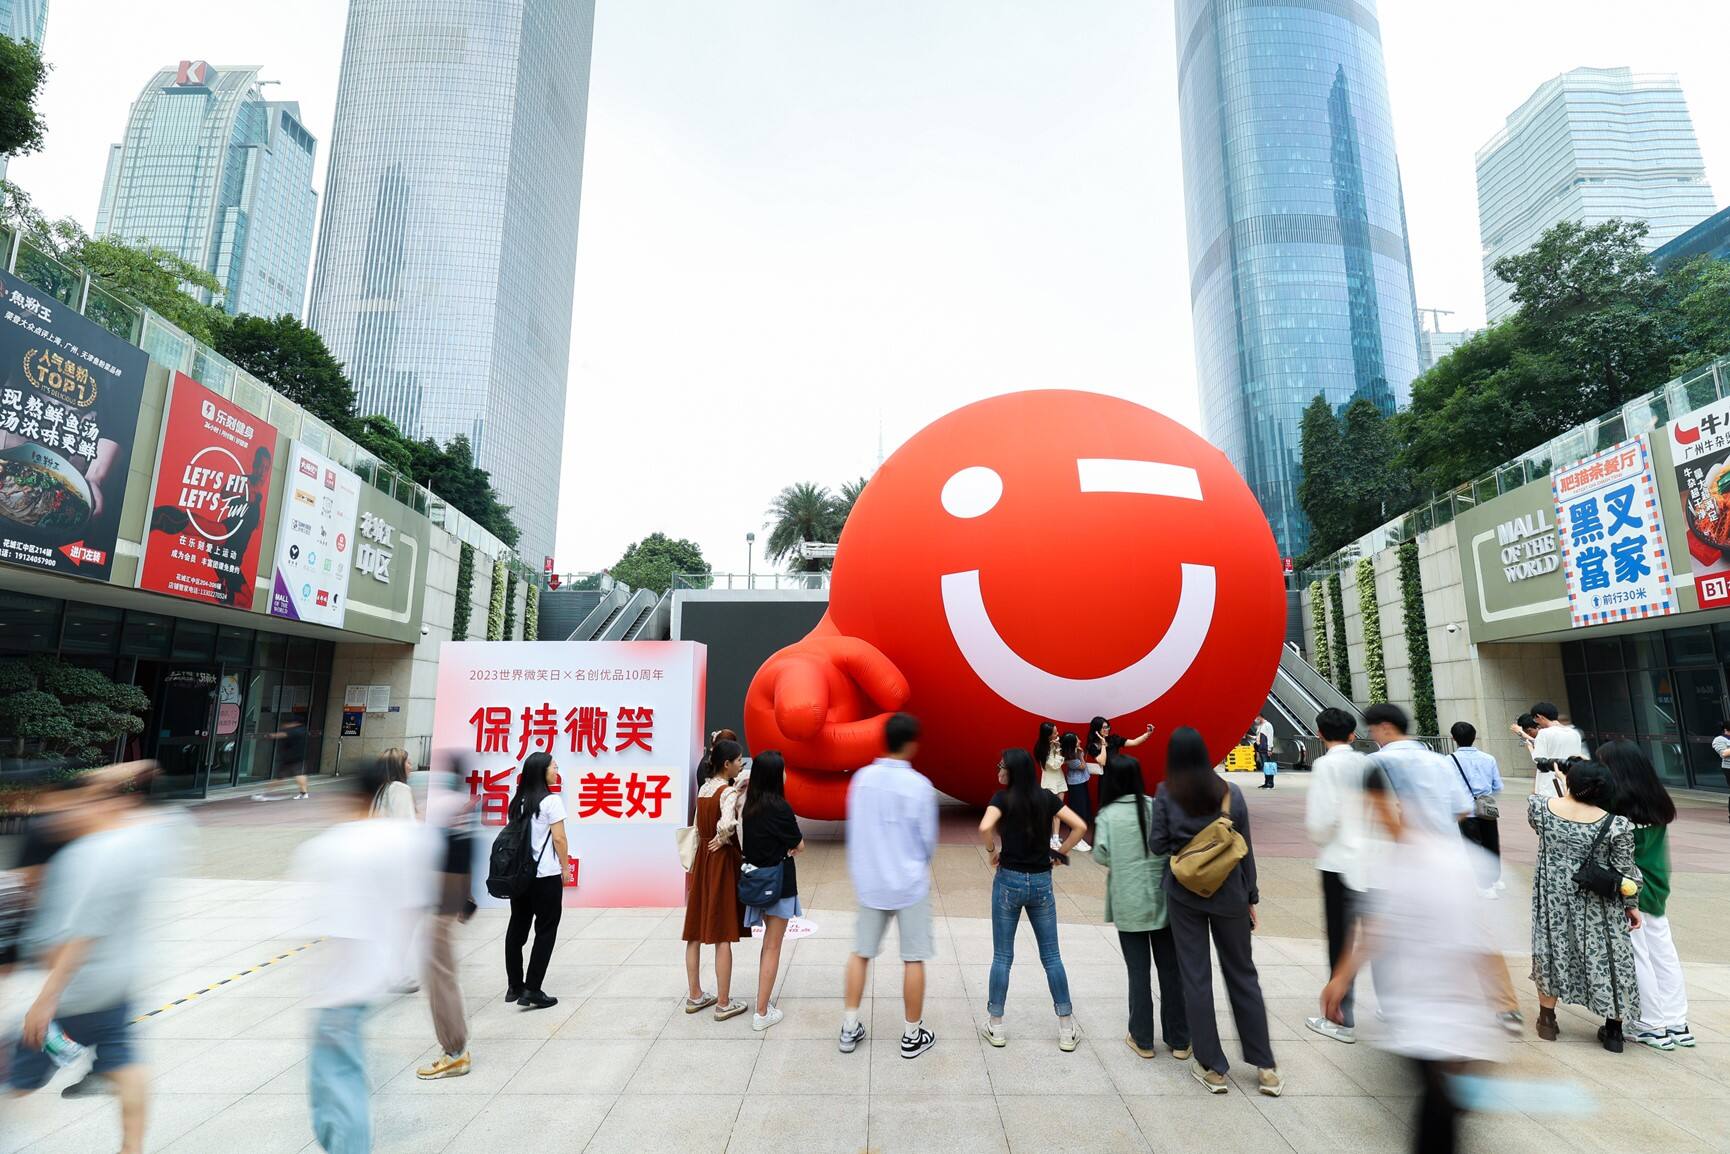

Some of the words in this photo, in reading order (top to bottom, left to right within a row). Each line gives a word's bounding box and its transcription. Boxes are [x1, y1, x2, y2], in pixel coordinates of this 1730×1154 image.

[37, 365, 86, 400] TOP1
[38, 348, 88, 384] 人气鱼粉
[2, 388, 99, 441] 现熬鲜鱼汤
[216, 410, 254, 439] 乐刻健身
[1701, 412, 1730, 435] 牛
[0, 409, 96, 461] 汤浓味更鲜
[182, 465, 224, 489] LET'S
[226, 474, 248, 493] FIT
[1560, 448, 1636, 493] 肥猫茶餐厅
[178, 487, 221, 511] LET'S
[217, 495, 249, 522] Fun
[1569, 484, 1643, 547] 黑叉
[1497, 509, 1554, 546] MALL
[70, 545, 101, 563] 进门左转
[1501, 545, 1521, 565] OF
[1521, 533, 1556, 559] THE
[1576, 535, 1651, 592] 當家
[1504, 555, 1559, 583] WORLD
[1602, 587, 1647, 605] 前行30米
[1706, 581, 1723, 597] B1
[469, 702, 654, 761] 保持微笑
